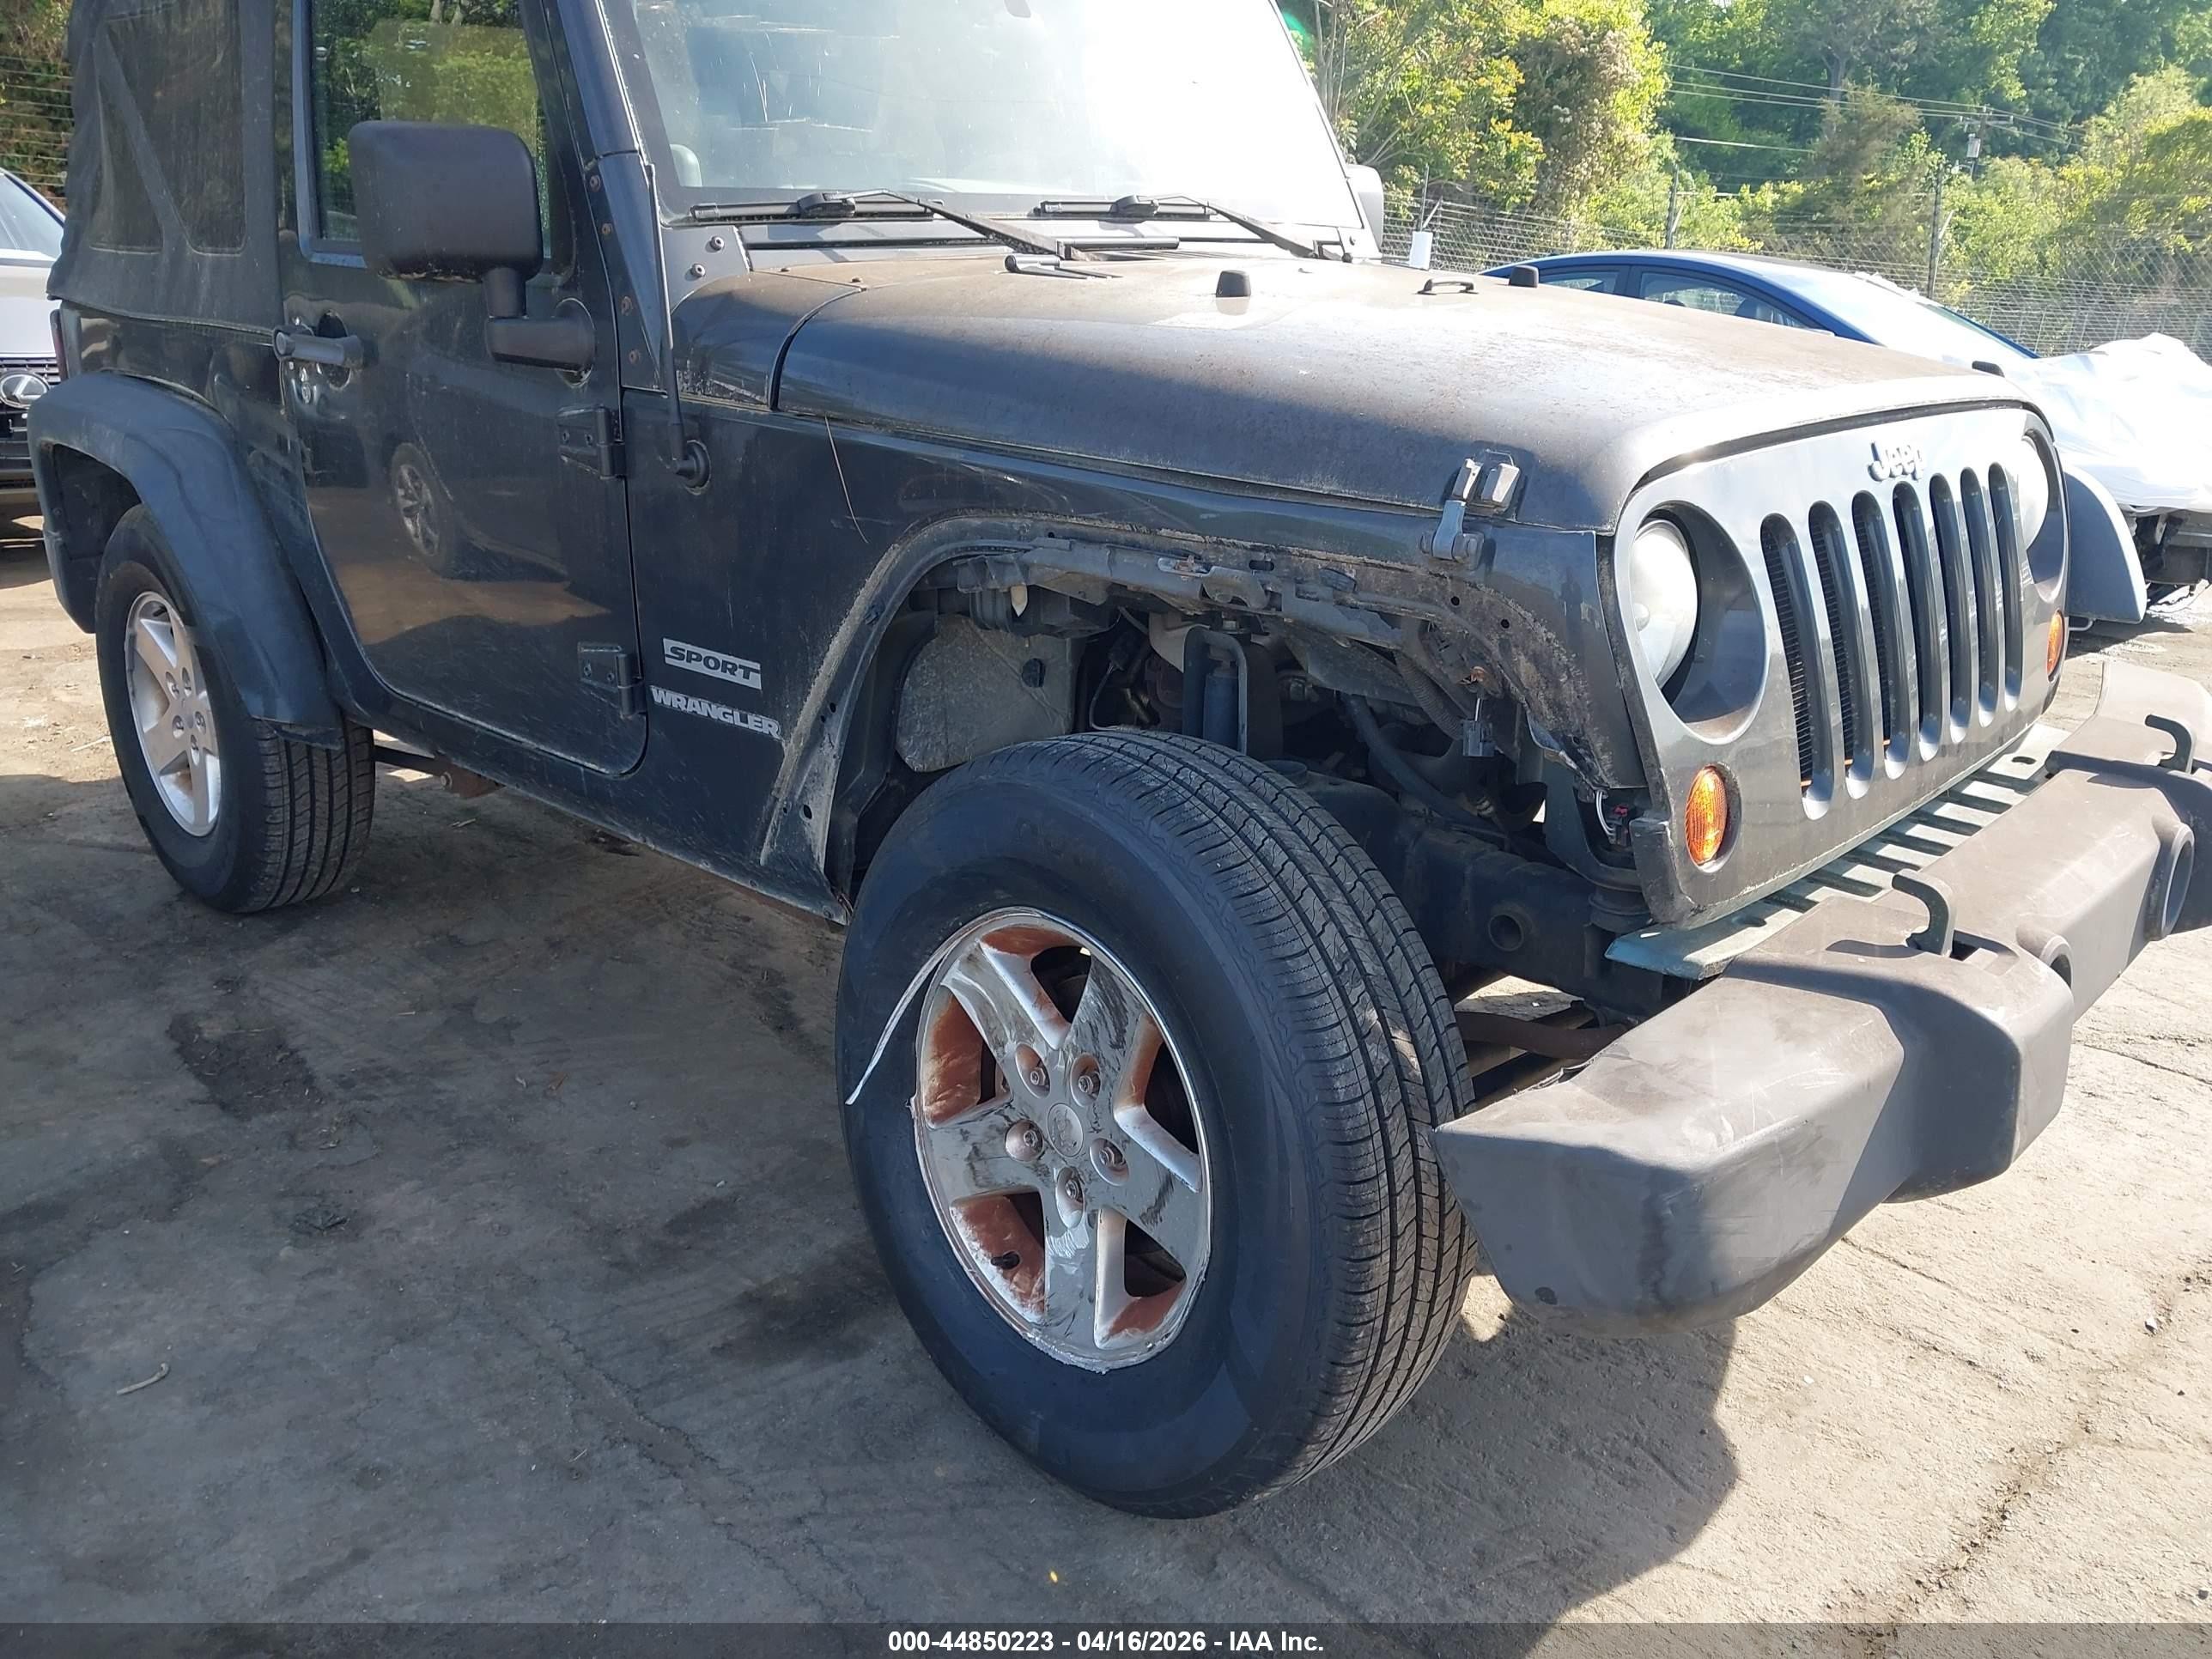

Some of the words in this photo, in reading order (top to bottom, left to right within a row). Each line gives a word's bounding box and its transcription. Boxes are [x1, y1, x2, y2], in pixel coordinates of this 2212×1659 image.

[1867, 441, 1924, 482] Jeep
[665, 646, 761, 680] SPORT
[650, 685, 781, 740] WRANGLER
